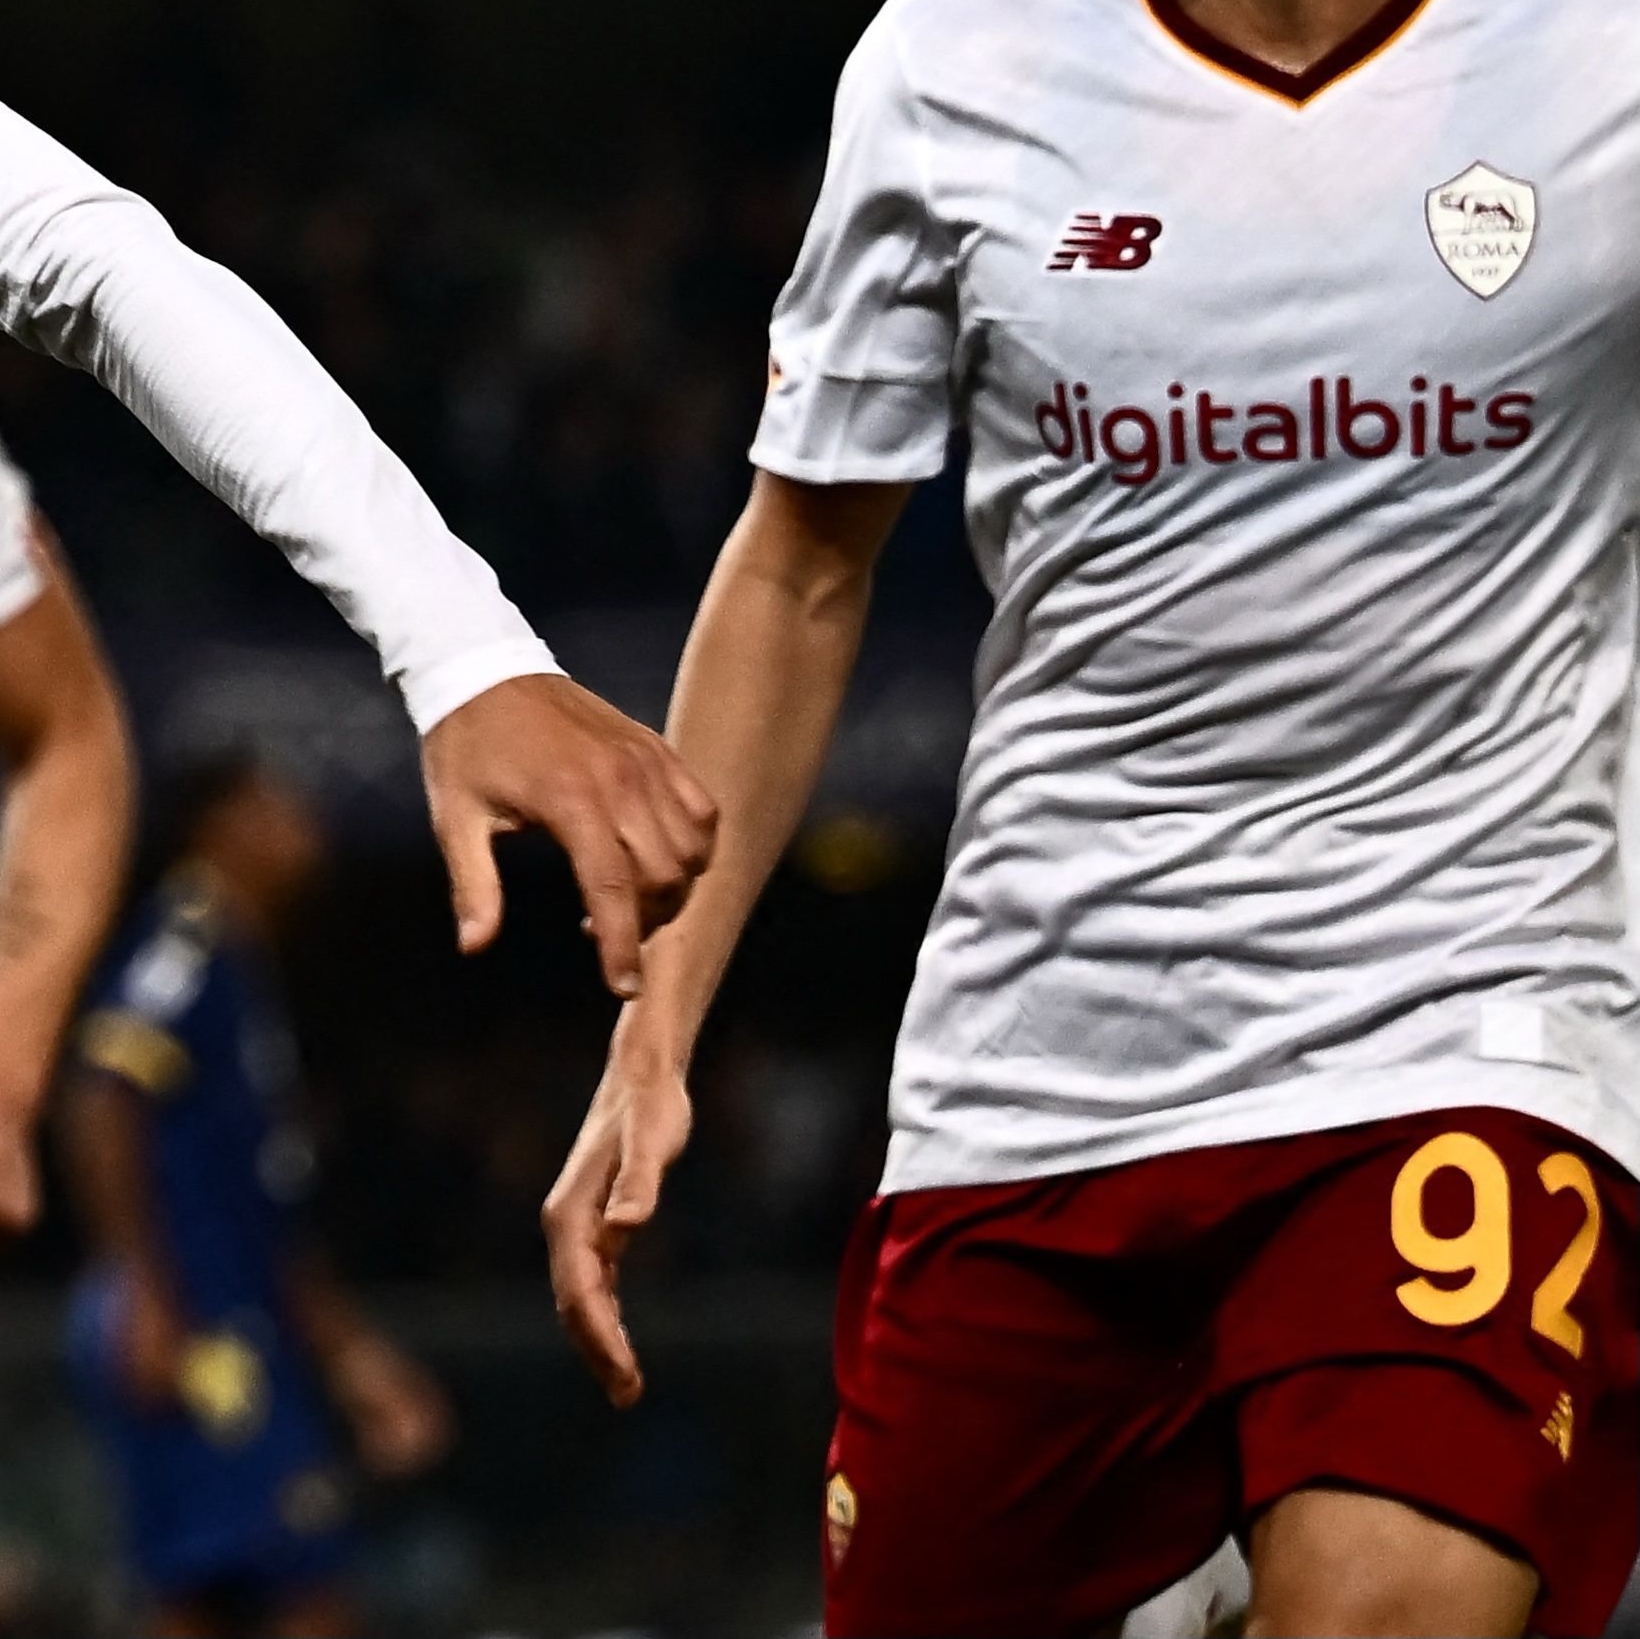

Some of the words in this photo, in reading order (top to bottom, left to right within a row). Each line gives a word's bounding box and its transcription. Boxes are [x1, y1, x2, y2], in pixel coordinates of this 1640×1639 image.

[1447, 242, 1519, 262] ROMA
[1035, 375, 1535, 486] digitalbits
[1390, 1131, 1601, 1360] 92
